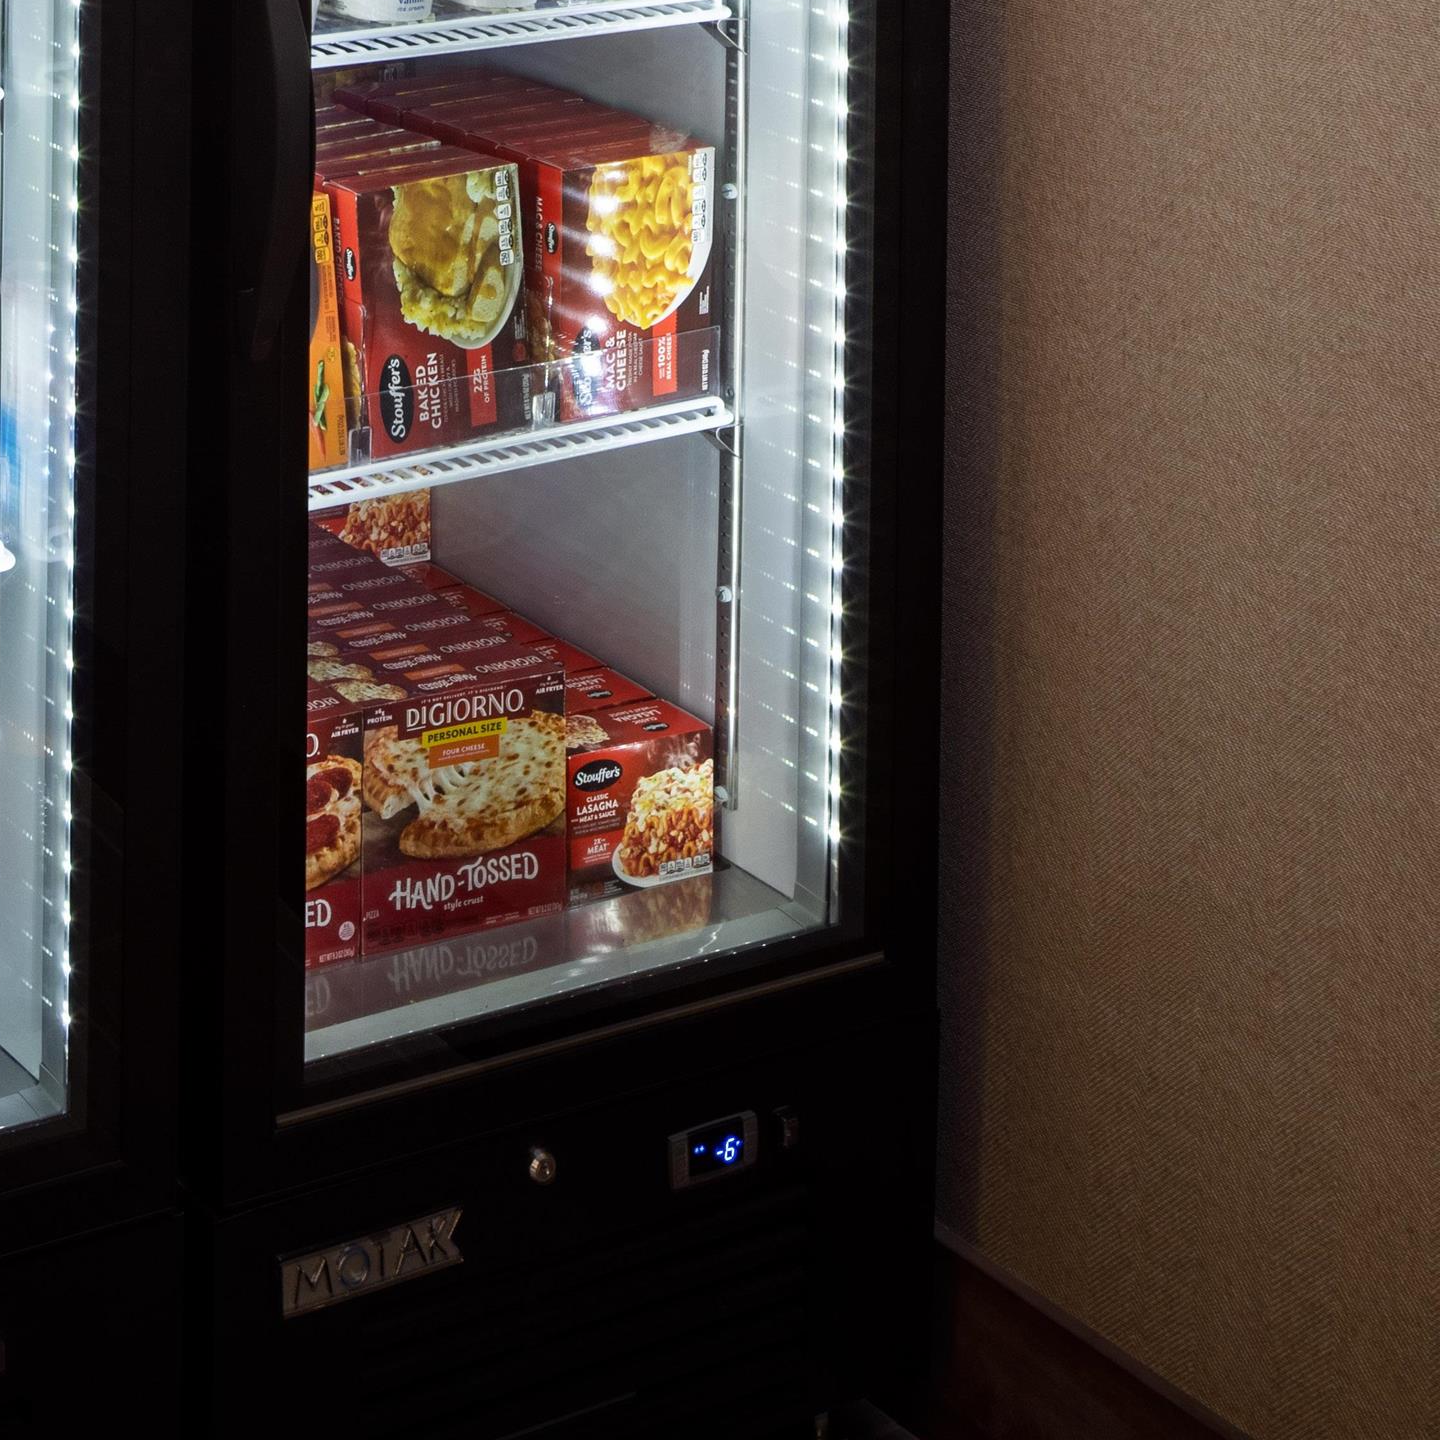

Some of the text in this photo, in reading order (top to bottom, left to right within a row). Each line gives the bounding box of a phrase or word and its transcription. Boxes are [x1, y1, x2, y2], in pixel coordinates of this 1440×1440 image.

[615, 329, 627, 392] CHEESE
[388, 357, 406, 439] Stouffer's
[416, 365, 429, 423] BAKED
[426, 352, 442, 430] CHICKEN
[427, 721, 503, 744] PERSONAL SIZE
[442, 743, 486, 757] FOUR CHEESE
[574, 765, 622, 788] Stouffer's
[576, 799, 620, 816] LASAGNA
[586, 792, 610, 803] CLASSIC
[587, 843, 608, 856] MEAT
[388, 852, 539, 912] HAND-TOSSED
[444, 895, 484, 912] style crust
